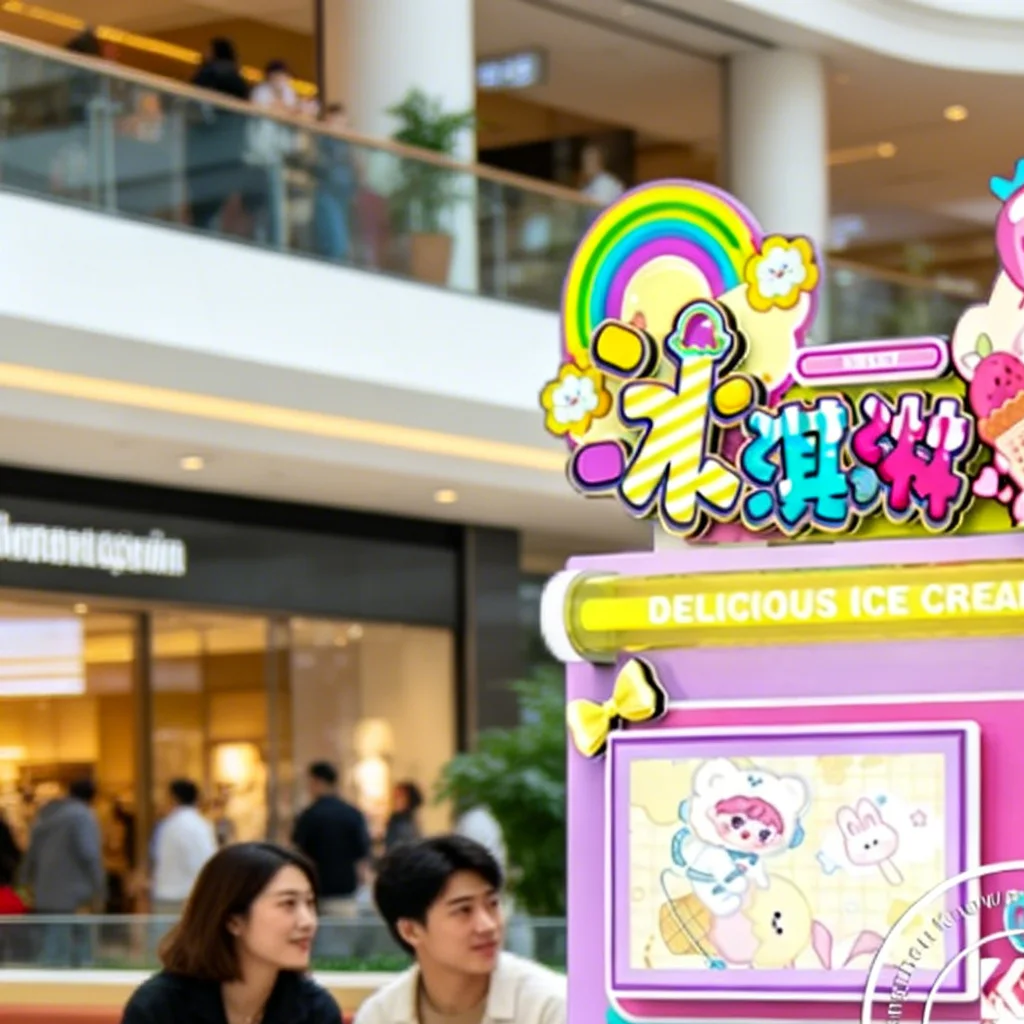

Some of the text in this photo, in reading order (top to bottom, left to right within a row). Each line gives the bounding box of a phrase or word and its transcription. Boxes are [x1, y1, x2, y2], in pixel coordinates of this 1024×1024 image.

[570, 302, 972, 534] 冰淇淋
[648, 587, 838, 625] DELICIOUS
[850, 585, 910, 617] ICE
